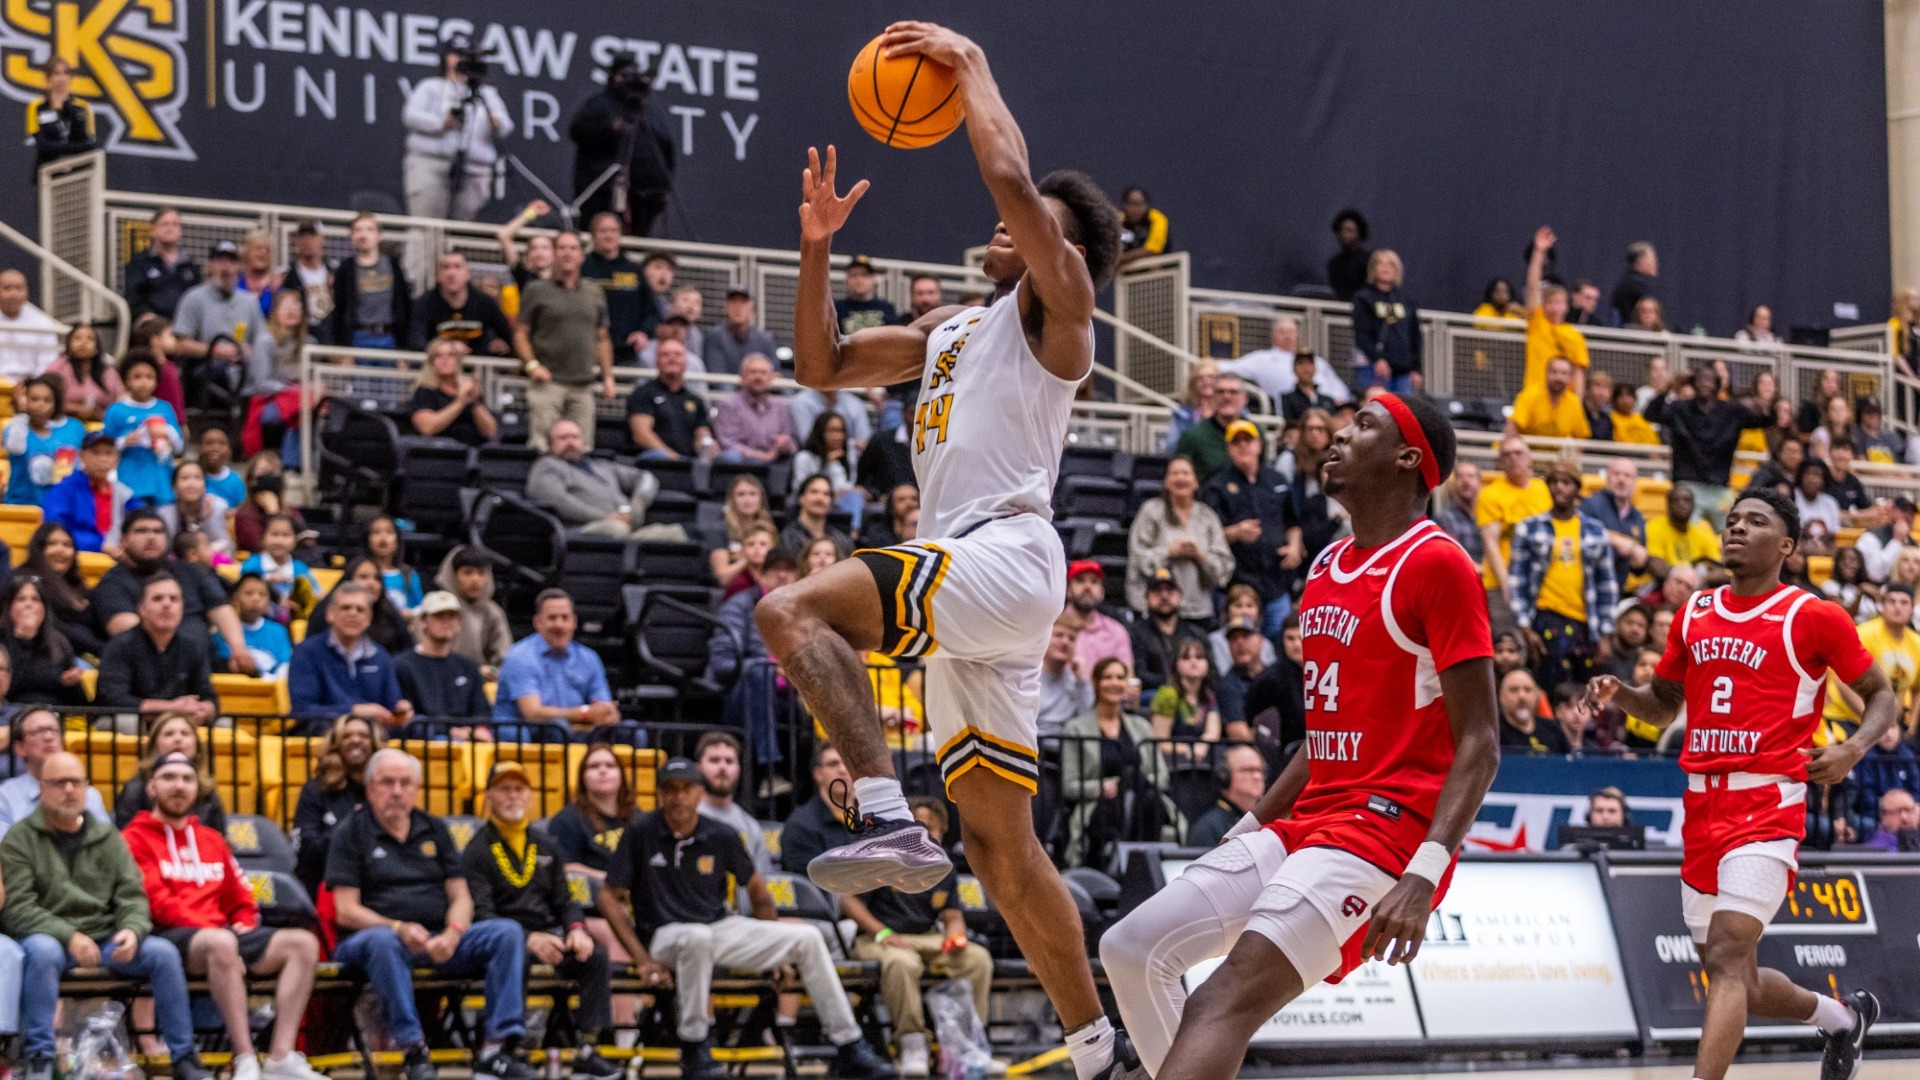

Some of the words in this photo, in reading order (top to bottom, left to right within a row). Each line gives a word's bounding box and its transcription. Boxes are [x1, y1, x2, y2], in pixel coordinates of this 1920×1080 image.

[590, 34, 760, 101] STATE
[915, 393, 955, 455] 14
[1697, 595, 1713, 607] 45
[1690, 636, 1768, 671] WESTERN
[1304, 660, 1340, 712] 24
[1710, 675, 1734, 714] 2
[1688, 728, 1762, 754] ENTUCKY
[1388, 803, 1398, 815] XL
[1473, 913, 1573, 927] AMERICAN
[1476, 931, 1578, 947] CAMPUS
[1794, 944, 1848, 967] PERIOD
[1419, 960, 1470, 982] Where
[1471, 960, 1538, 982] students
[1536, 959, 1569, 981] love
